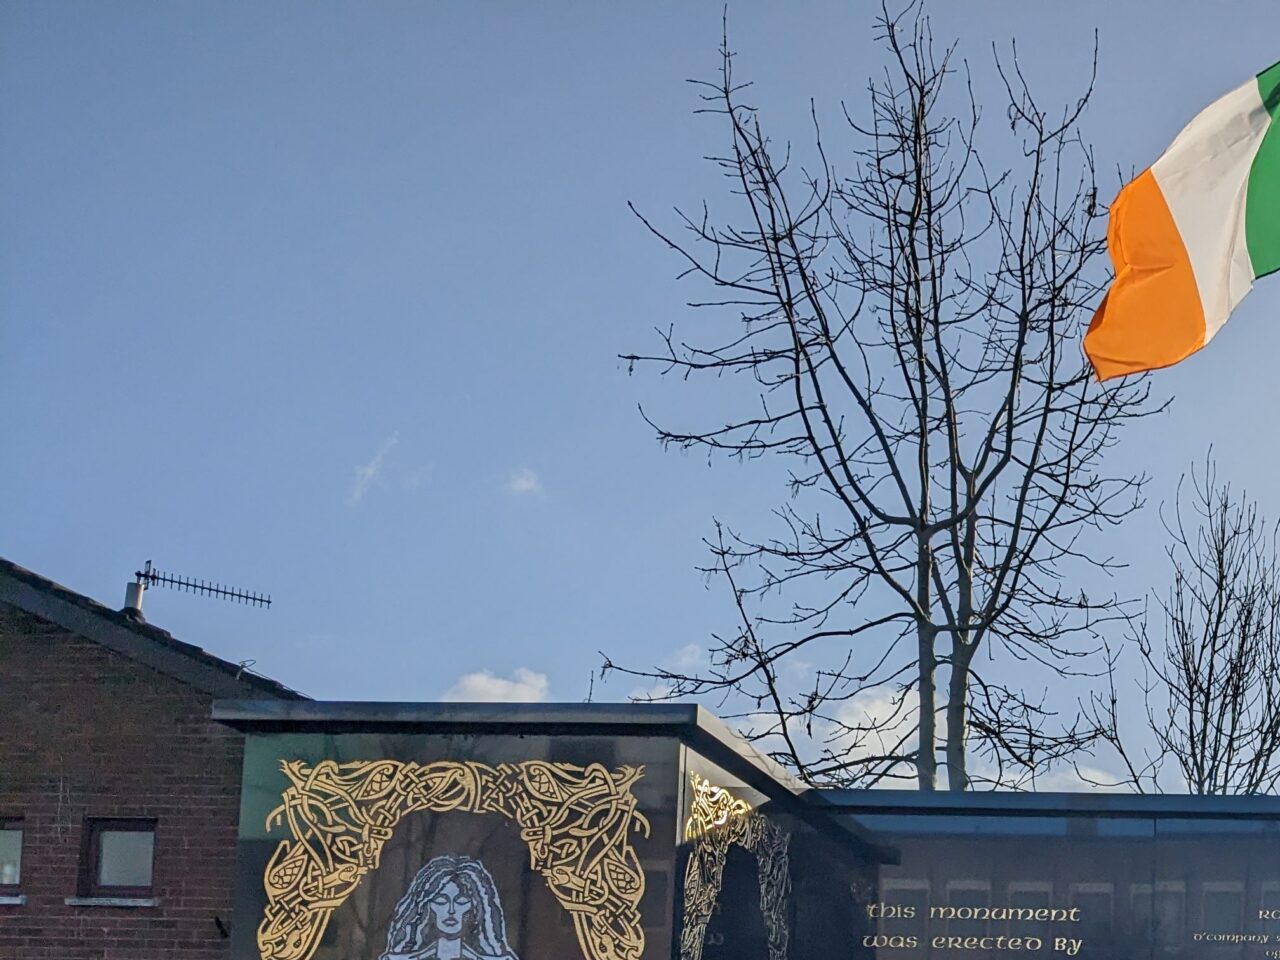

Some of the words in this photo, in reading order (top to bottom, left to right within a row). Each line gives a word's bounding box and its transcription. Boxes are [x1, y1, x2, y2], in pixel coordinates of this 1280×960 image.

[867, 902, 915, 919] this
[930, 906, 1080, 922] monument
[863, 936, 917, 948] was
[932, 937, 1041, 951] erected
[1054, 937, 1082, 956] by
[1193, 933, 1268, 946] d'company
